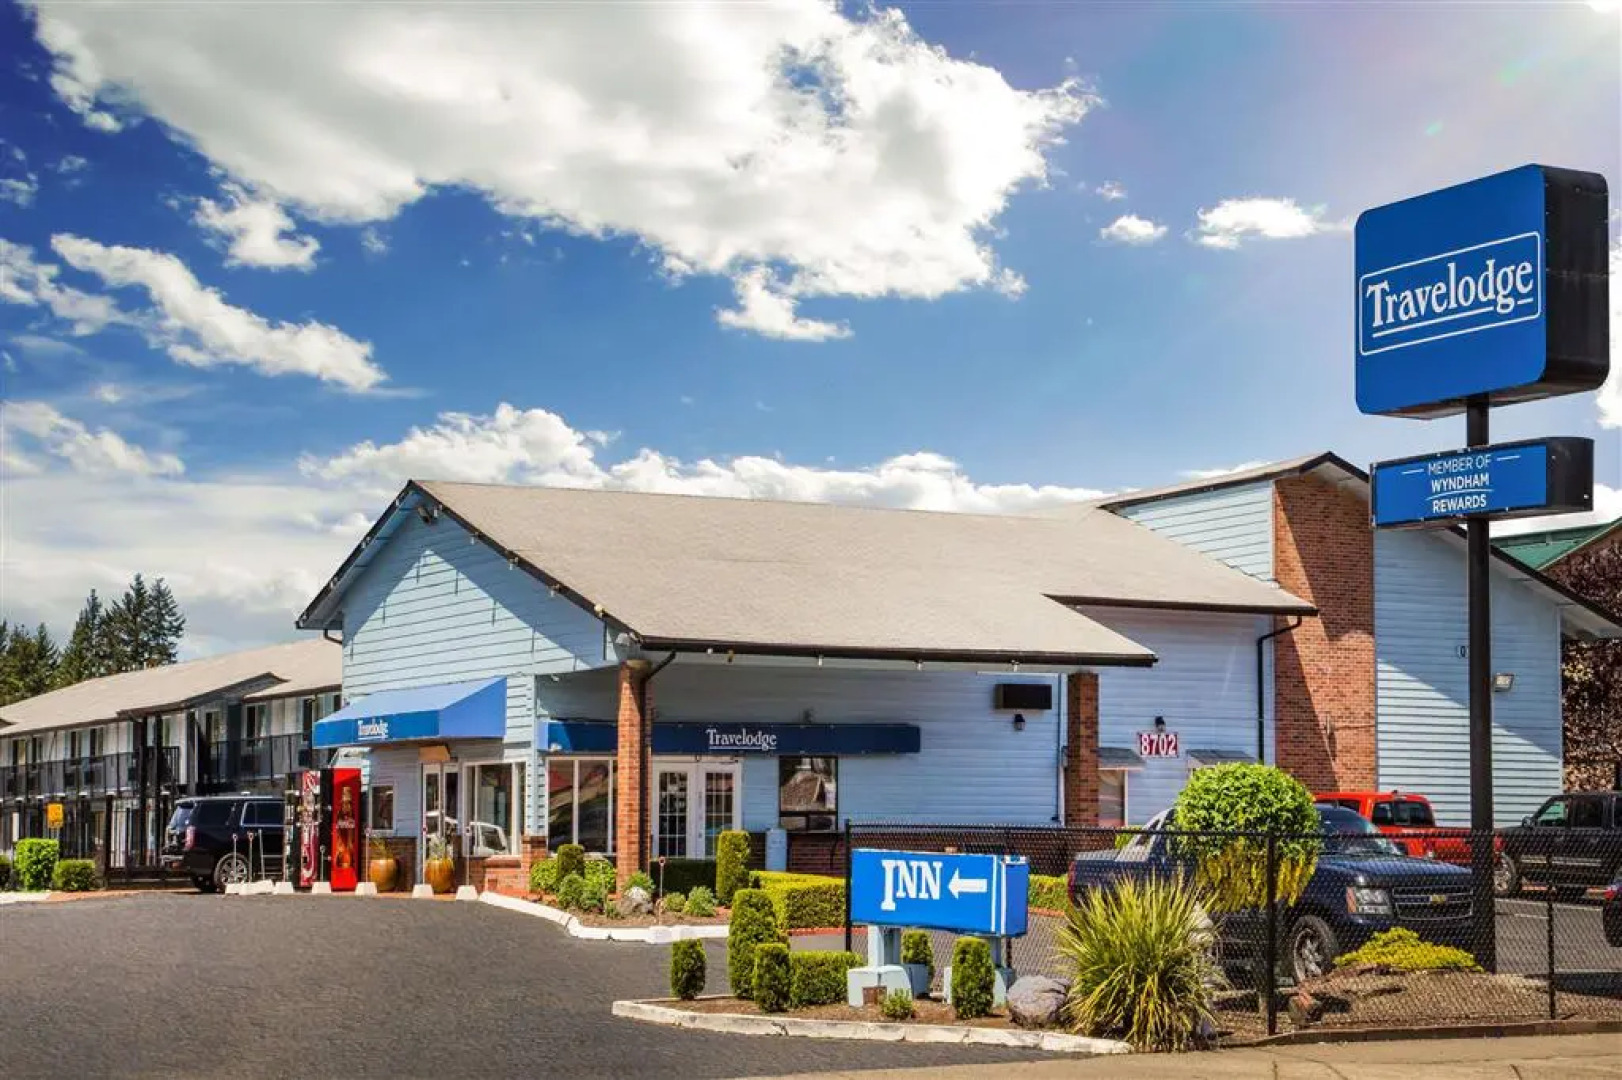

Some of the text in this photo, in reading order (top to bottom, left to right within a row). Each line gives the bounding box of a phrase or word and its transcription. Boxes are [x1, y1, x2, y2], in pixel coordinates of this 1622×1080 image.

[1366, 259, 1534, 327] Travelodge
[1428, 455, 1492, 475] MEMBER OF
[1431, 472, 1489, 493] WYNDHAM
[1432, 493, 1487, 513] REWARDS
[705, 727, 777, 751] Travelodge
[1141, 733, 1177, 756] 8702
[880, 859, 943, 911] INN
